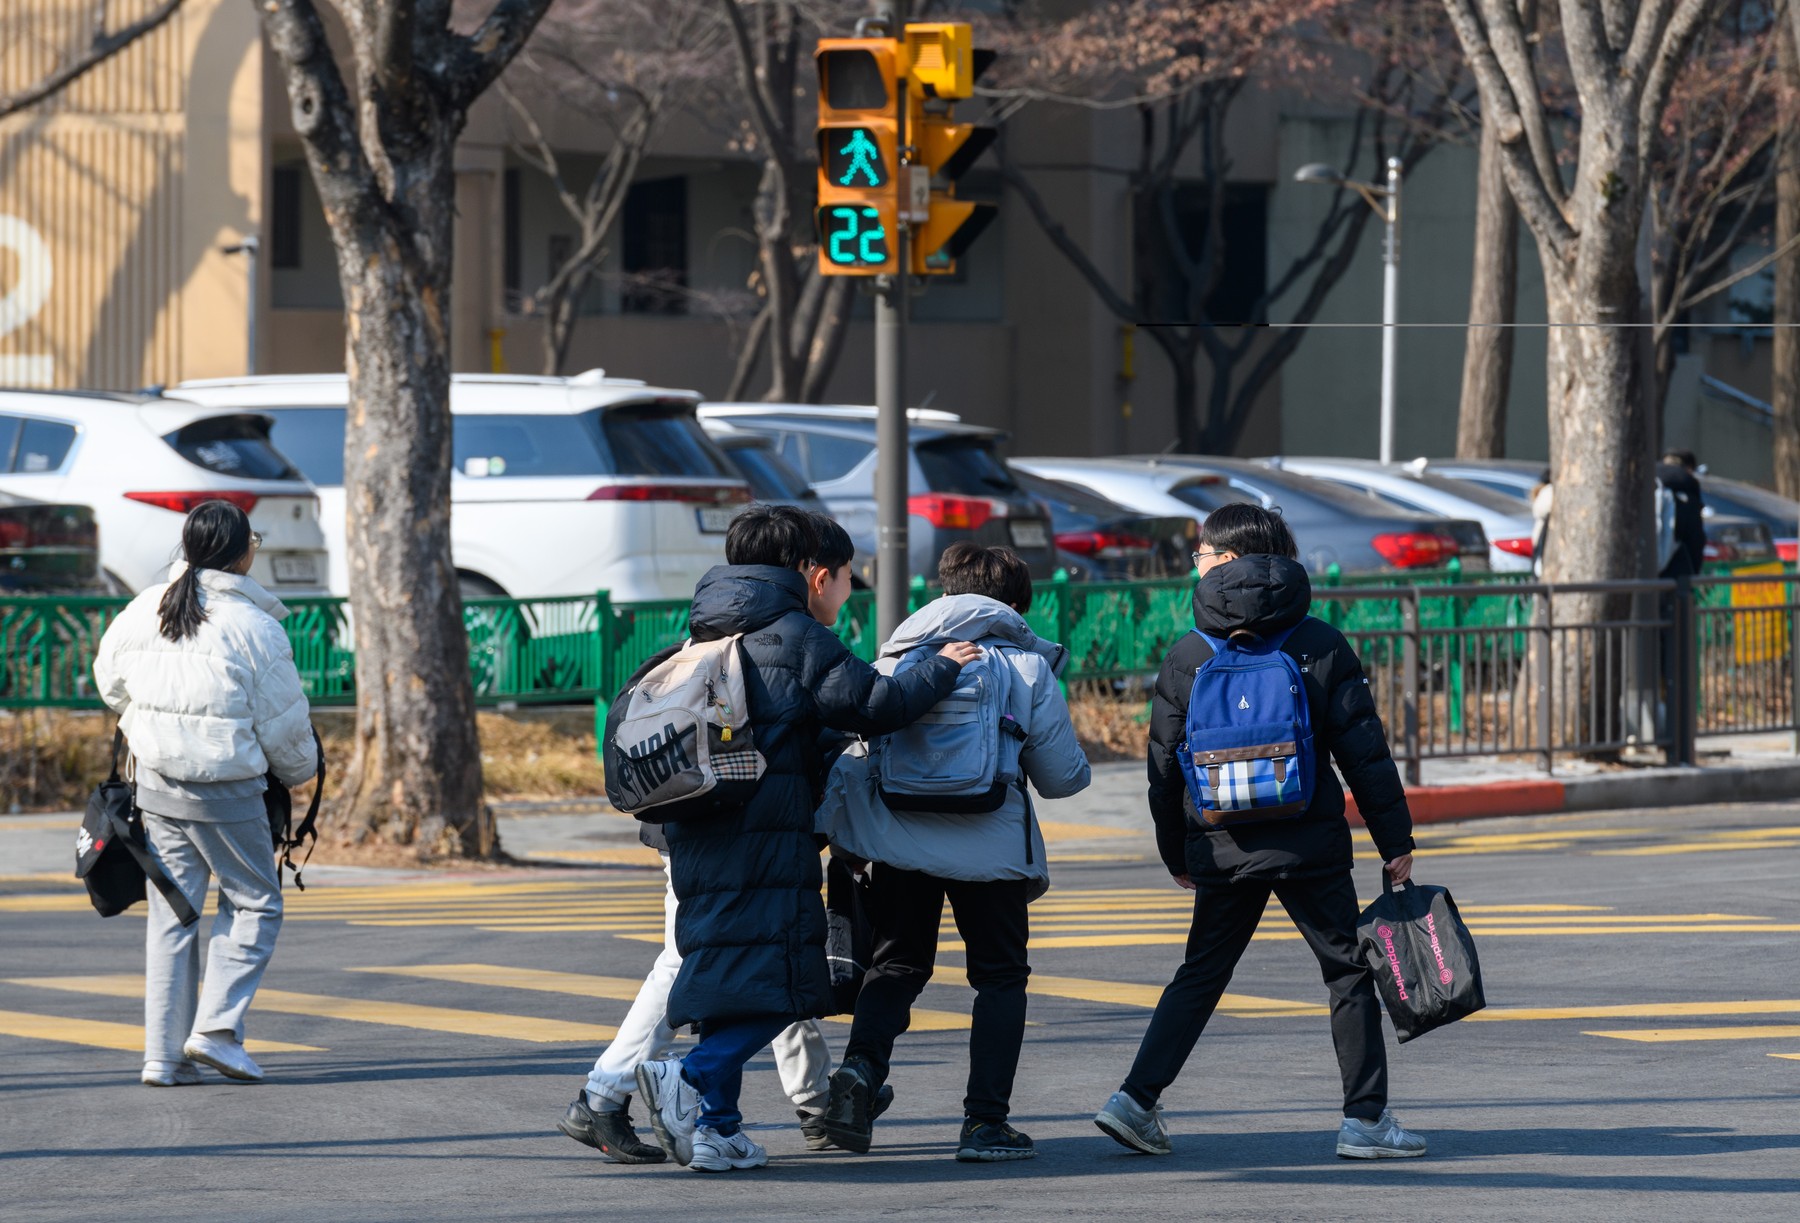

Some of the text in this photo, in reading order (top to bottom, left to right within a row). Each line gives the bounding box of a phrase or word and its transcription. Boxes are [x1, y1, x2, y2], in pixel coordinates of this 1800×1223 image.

[830, 207, 885, 263] 22
[630, 722, 692, 796] NBA
[1384, 938, 1409, 1001] applerind
[1426, 912, 1445, 971] applerind
